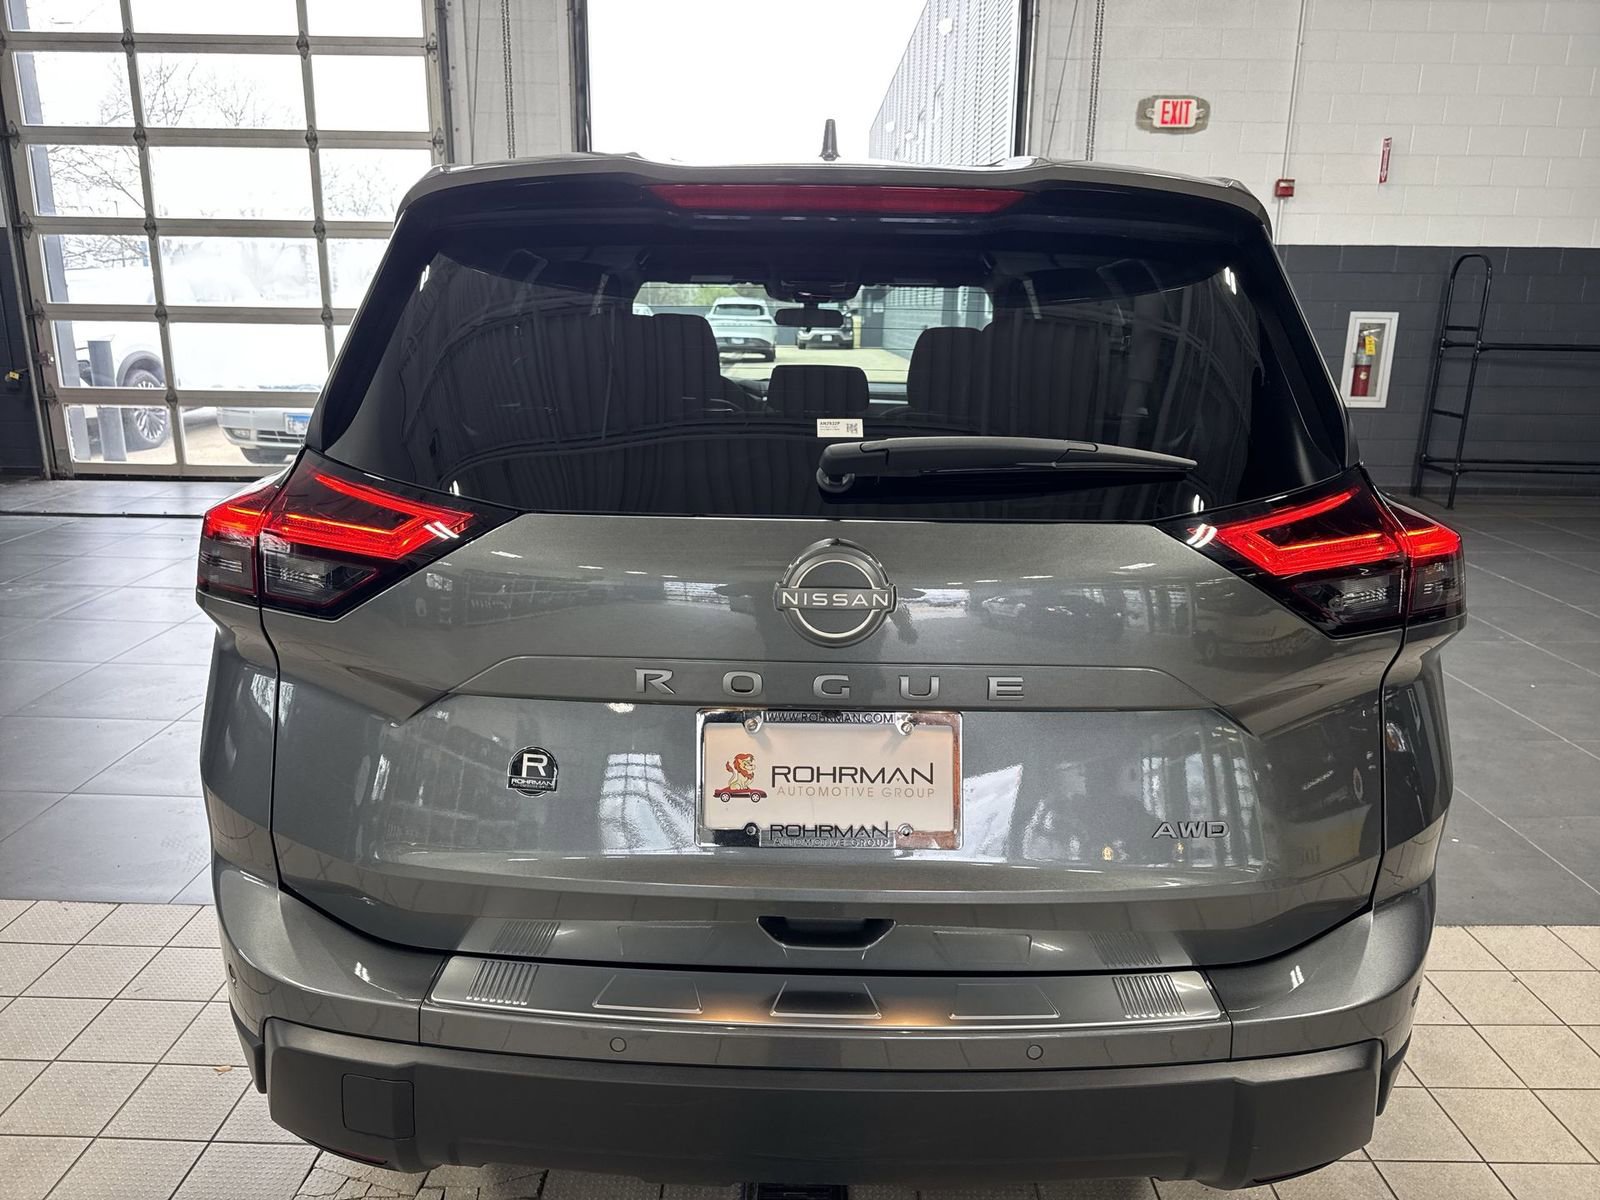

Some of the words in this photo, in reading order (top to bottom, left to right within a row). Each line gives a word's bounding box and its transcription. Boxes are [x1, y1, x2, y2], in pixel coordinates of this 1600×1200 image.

[1161, 101, 1192, 124] EXIT
[782, 592, 888, 606] NISSAN
[635, 668, 1024, 701] ROGUE
[522, 753, 548, 777] R
[511, 778, 554, 786] ROHRMAN
[771, 762, 934, 788] ROHRMAN
[777, 786, 874, 798] AUTOMOTIVE
[881, 787, 935, 798] GROUP
[769, 821, 889, 840] ROHRMAN
[1152, 821, 1229, 839] AWD
[773, 838, 845, 847] AUTOMOTIVE
[851, 839, 890, 848] GROUP
